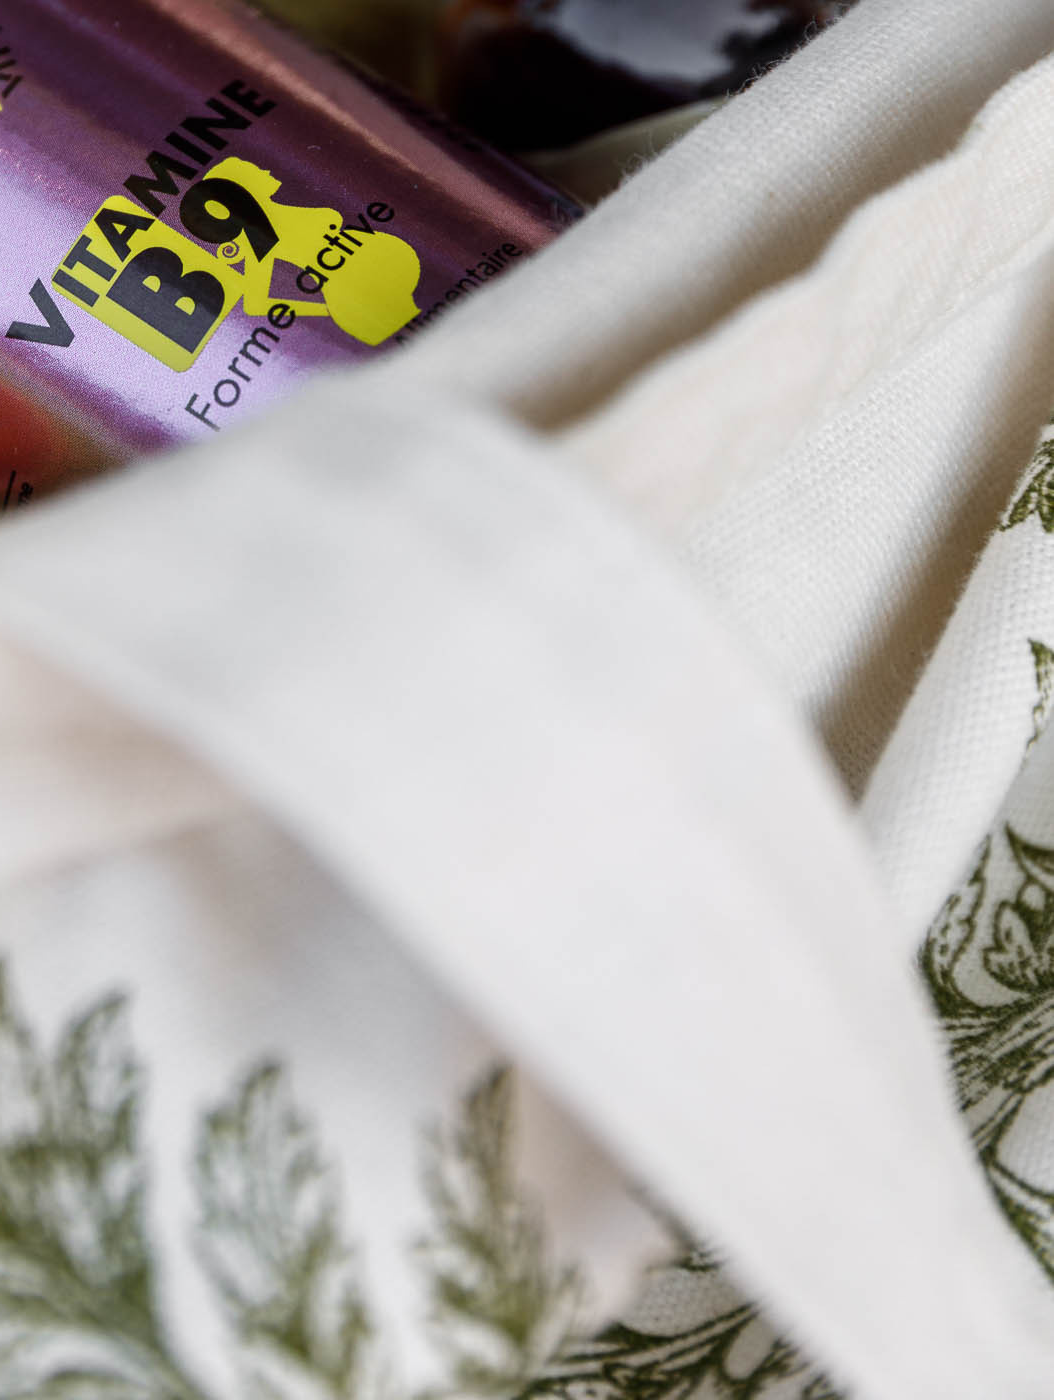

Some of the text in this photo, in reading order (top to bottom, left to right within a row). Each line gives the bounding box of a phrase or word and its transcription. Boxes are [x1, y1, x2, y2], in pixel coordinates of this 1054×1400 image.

[4, 79, 278, 348] VITAMINE
[105, 177, 280, 355] B9
[184, 201, 396, 432] Forme active
